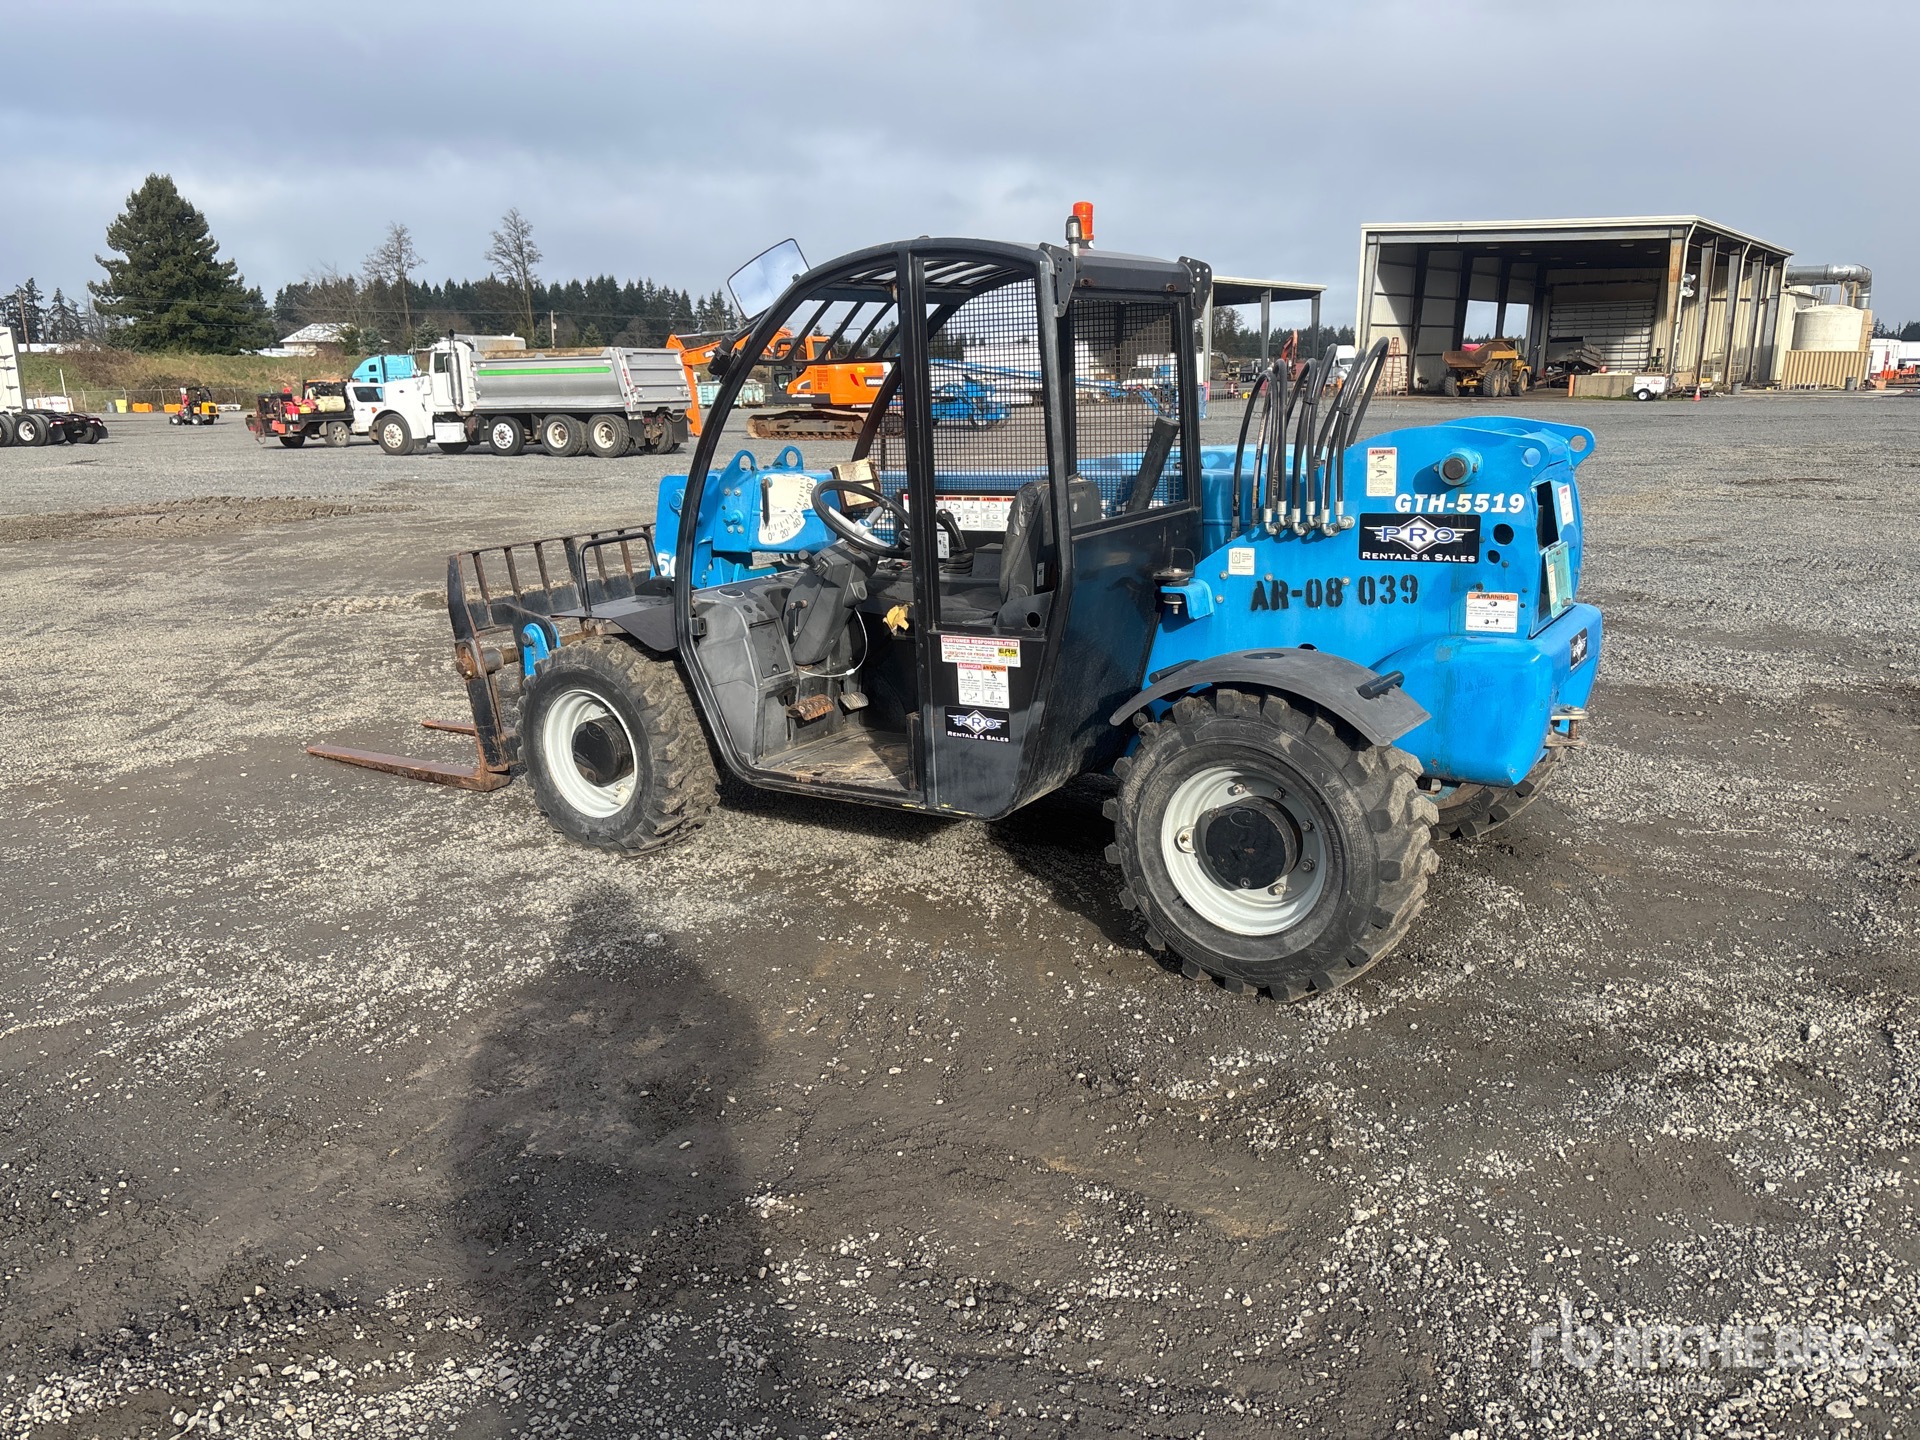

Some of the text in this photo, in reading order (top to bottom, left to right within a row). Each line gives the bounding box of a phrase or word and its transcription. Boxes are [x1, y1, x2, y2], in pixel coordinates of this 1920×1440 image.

[1395, 493, 1525, 513] GTH-5519
[1381, 526, 1455, 544] PRO
[1362, 551, 1418, 560] RENTALS
[1435, 553, 1476, 562] SALES
[1251, 574, 1418, 611] AR-08 039
[971, 639, 1018, 647] RESPONSIBILITIES
[956, 715, 997, 729] PRO
[947, 731, 978, 739] RENTALS
